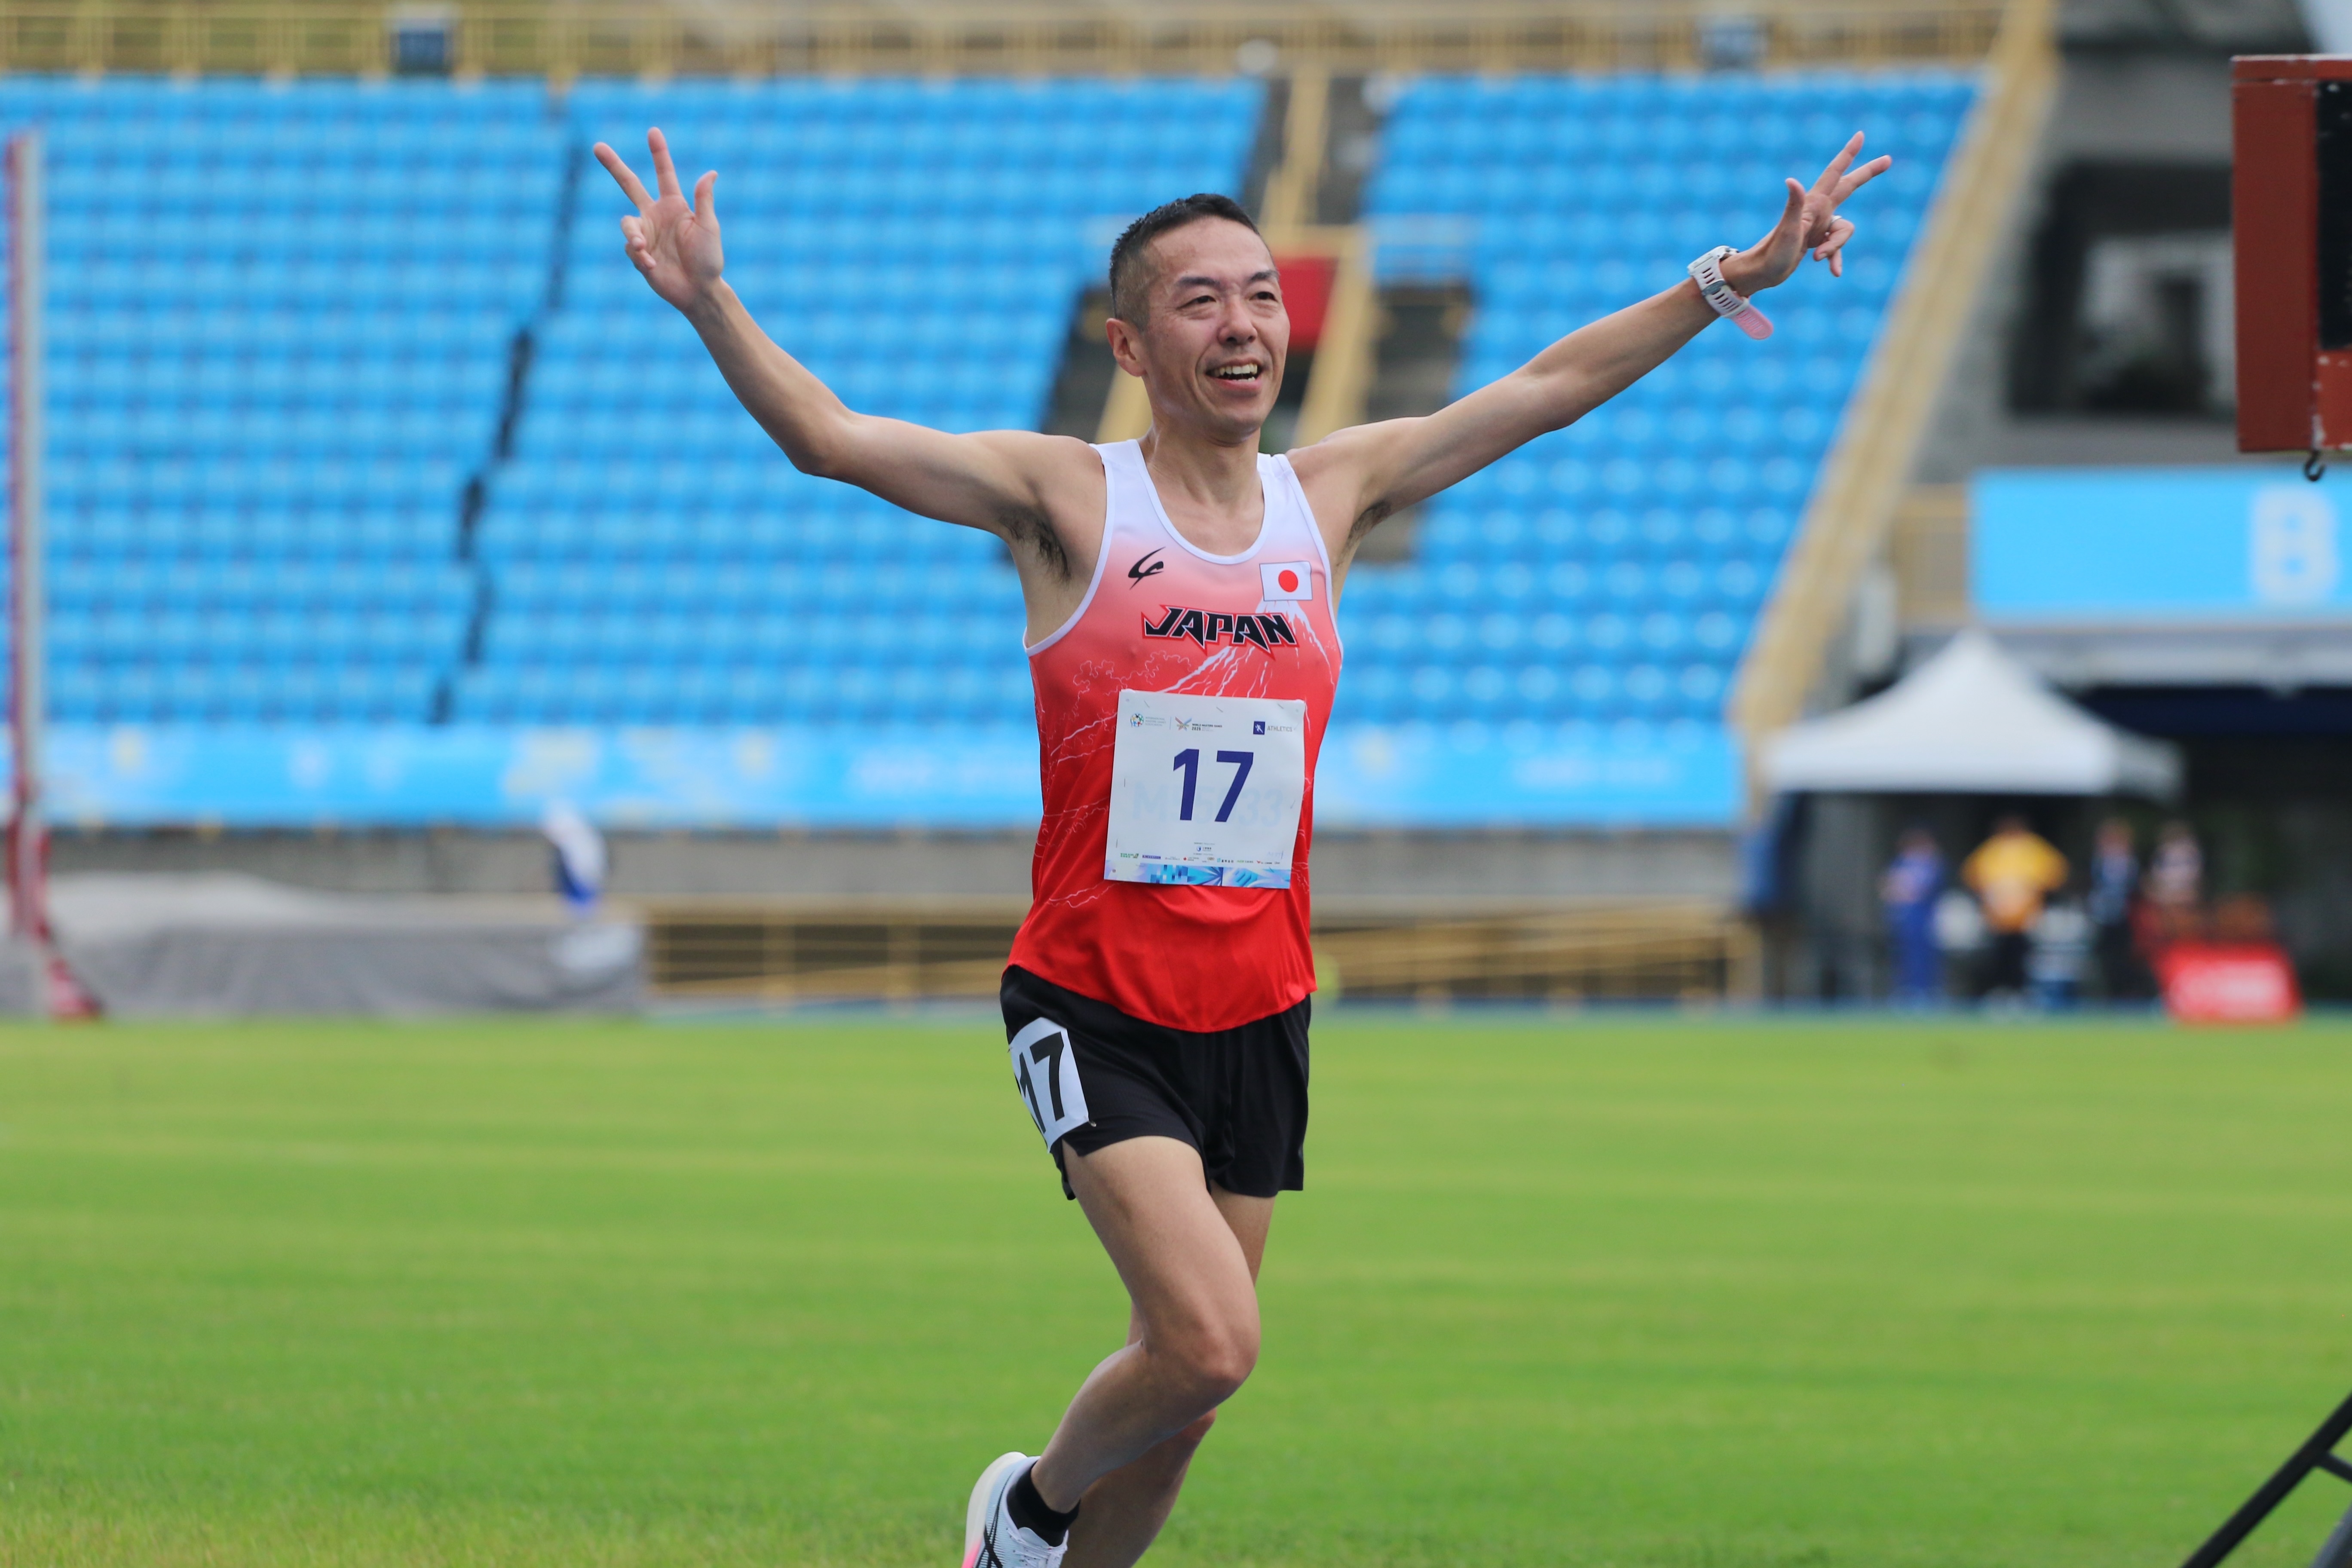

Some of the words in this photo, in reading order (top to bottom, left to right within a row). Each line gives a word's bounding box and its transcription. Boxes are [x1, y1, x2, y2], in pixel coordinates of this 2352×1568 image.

[1142, 605, 1298, 659] JAPAN
[1173, 748, 1254, 822] 17
[1019, 1032, 1065, 1133] 17
